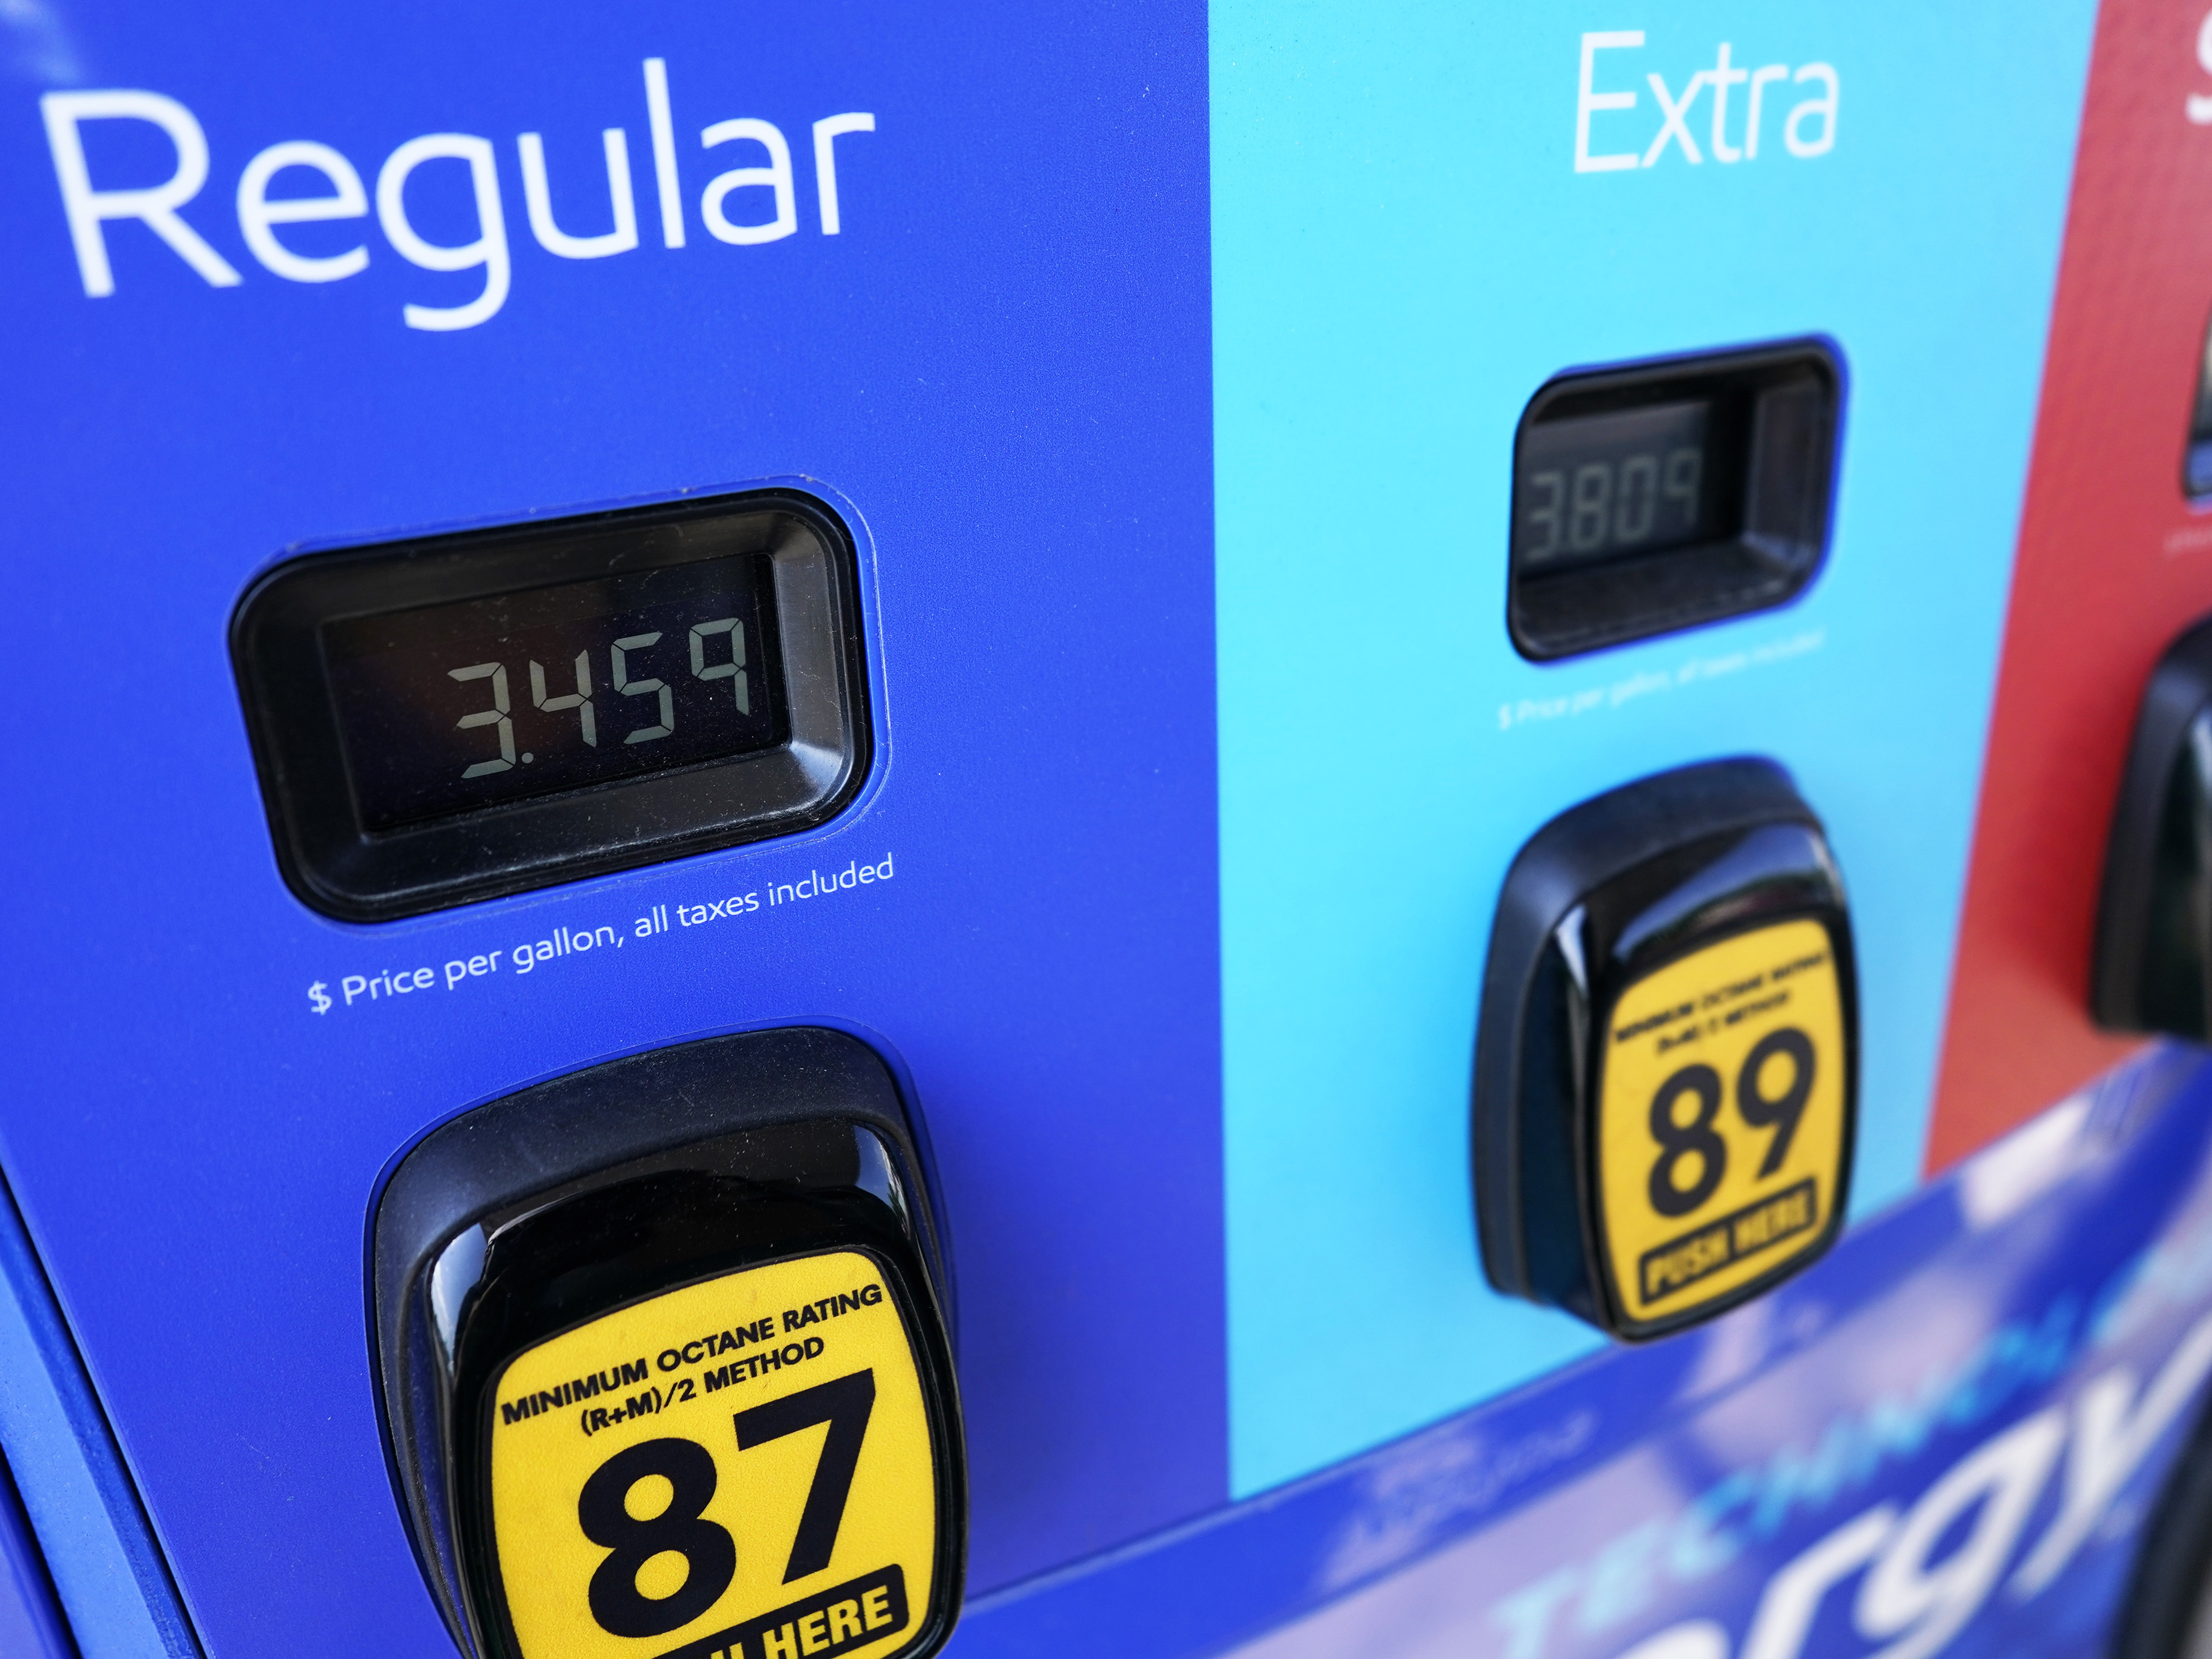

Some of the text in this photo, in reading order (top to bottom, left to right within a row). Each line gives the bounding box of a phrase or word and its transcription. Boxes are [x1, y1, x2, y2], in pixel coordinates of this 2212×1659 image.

[1573, 29, 1841, 174] Extra
[41, 58, 876, 331] Regular
[447, 617, 749, 779] 3.459
[307, 852, 894, 1015] $ Price per gallon, all taxes included
[1648, 1027, 1817, 1219] 89
[1645, 1224, 1730, 1296] PUSH
[501, 1283, 883, 1426] MINIMUM OCTANE RATING
[581, 1336, 824, 1437] (R+M)/2 METHOD
[578, 1367, 876, 1638] 87
[1611, 1312, 2212, 1659] rgy
[762, 1585, 893, 1659] HERE
